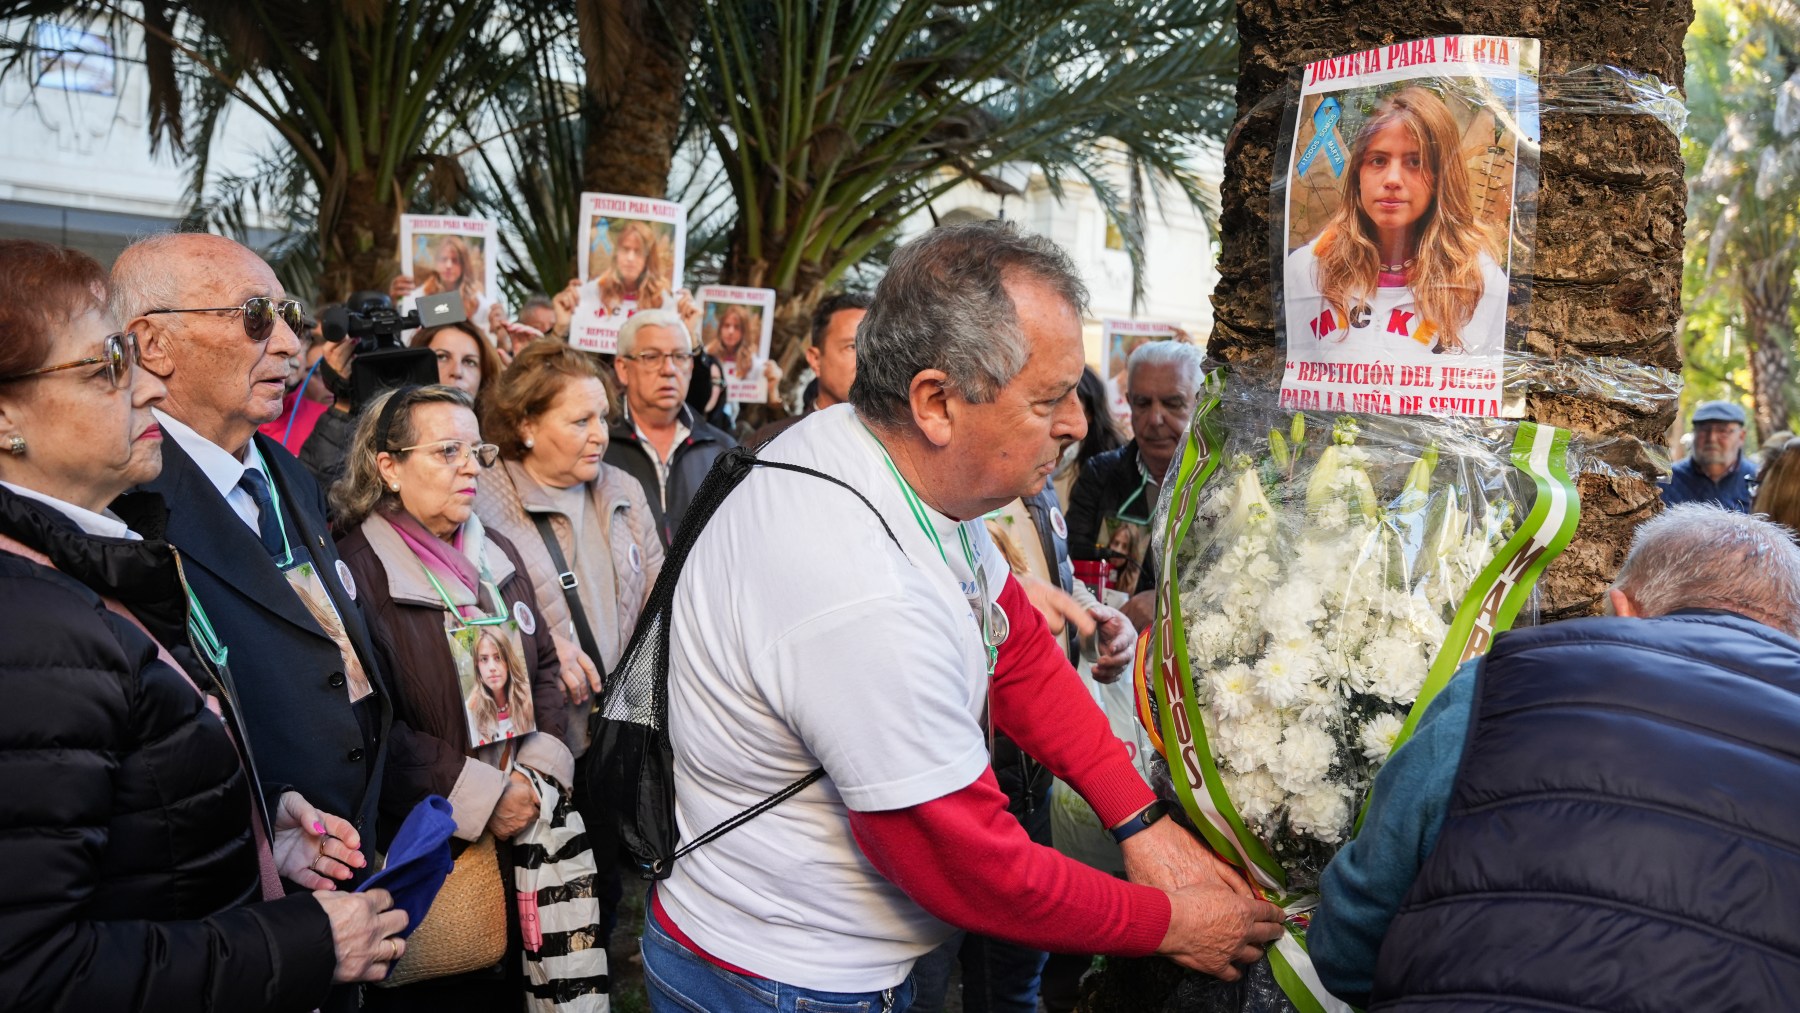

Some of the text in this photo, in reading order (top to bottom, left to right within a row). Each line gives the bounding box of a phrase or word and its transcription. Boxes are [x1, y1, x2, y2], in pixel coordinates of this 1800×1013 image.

[1387, 37, 1436, 69] PARA
[1320, 115, 1336, 137] SOMOS
[1328, 140, 1342, 165] MARTA!
[629, 201, 650, 215] PARA
[1297, 360, 1395, 386] REPETICIÓN
[1400, 365, 1434, 388] DEL
[1439, 366, 1497, 391] JUICIO
[1279, 388, 1499, 418] PARA LA NIÑA DE SEVILLA
[1161, 580, 1202, 790] SOMOS
